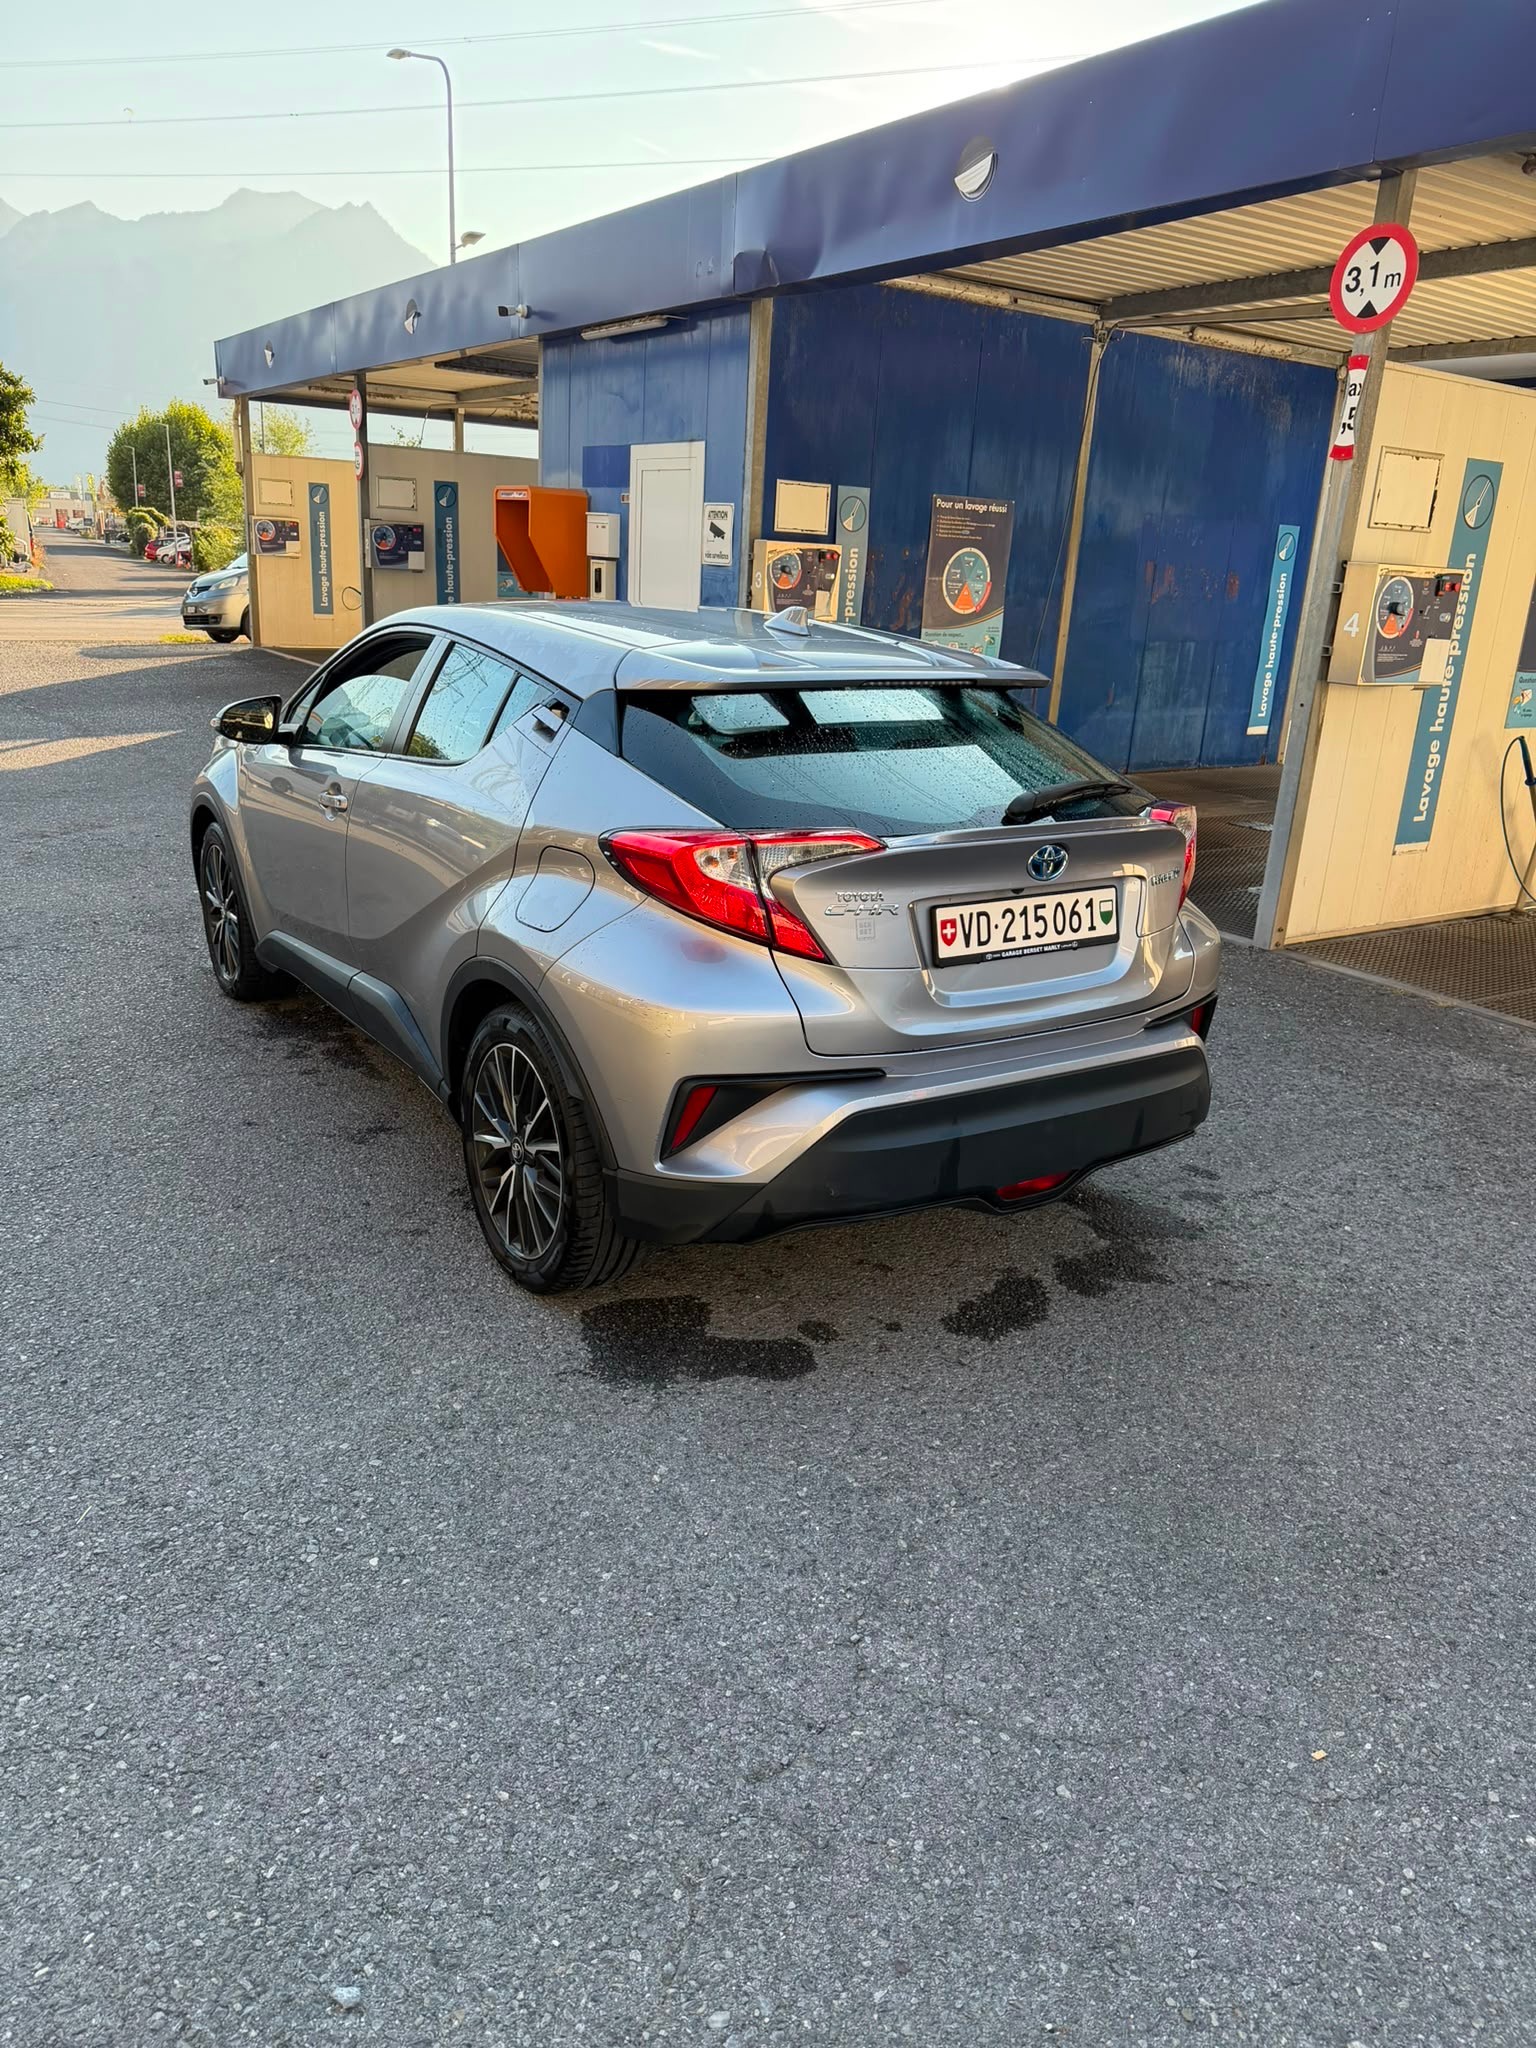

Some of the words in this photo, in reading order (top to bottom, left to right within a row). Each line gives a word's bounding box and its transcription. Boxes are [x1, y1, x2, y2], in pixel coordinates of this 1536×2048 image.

[1344, 261, 1380, 296] 3,1
[1384, 272, 1401, 289] m
[936, 498, 953, 509] Pour
[954, 502, 964, 510] un
[965, 500, 988, 514] lavage
[988, 503, 1008, 513] réussi
[317, 511, 329, 574] haute-pression
[444, 516, 456, 593] haute-pression
[320, 576, 330, 607] Lavage
[755, 572, 762, 588] 3
[844, 548, 859, 625] -pression
[1343, 612, 1360, 638] 4
[1257, 671, 1272, 717] Lavage
[1265, 573, 1288, 668] haute-pression
[1413, 739, 1440, 823] Lavage
[1429, 553, 1477, 733] haute-pression
[824, 903, 899, 916] C-HR
[836, 890, 884, 902] TOYOTA
[1001, 948, 1022, 957] GARAGE
